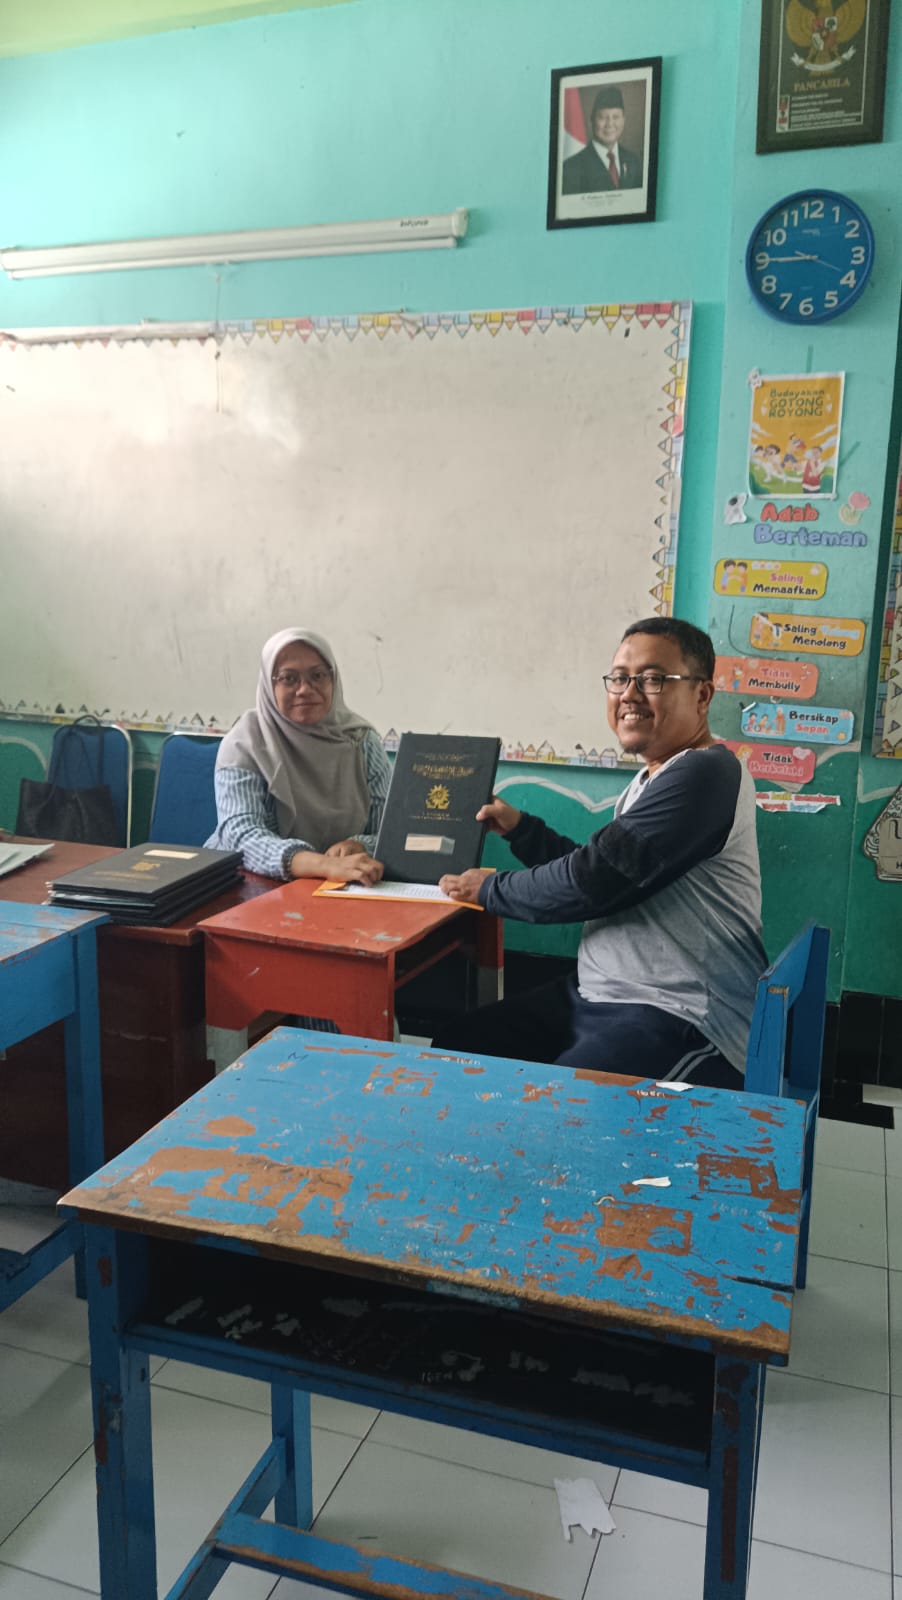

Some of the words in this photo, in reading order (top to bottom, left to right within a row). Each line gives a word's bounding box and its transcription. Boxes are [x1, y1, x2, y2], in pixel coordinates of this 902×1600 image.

[782, 210, 799, 227] 11
[801, 200, 824, 219] 12
[832, 206, 840, 223] 1
[764, 227, 787, 246] 10
[845, 220, 860, 238] 2
[755, 251, 770, 270] 9
[851, 246, 865, 265] 3
[761, 275, 776, 294] 8
[840, 270, 856, 288] 4
[779, 293, 792, 311] 7
[799, 298, 814, 316] 6
[823, 291, 839, 309] 5
[769, 396, 824, 408] GOTONG
[768, 406, 823, 418] ROYONG
[761, 503, 819, 522] Adab
[754, 524, 867, 547] Berteman
[770, 573, 804, 584] Saling
[753, 583, 818, 595] Memaafkan
[783, 623, 817, 636] Saling
[793, 636, 847, 650] Menolong
[748, 678, 801, 692] Membully
[789, 710, 839, 725] Bersikap
[762, 752, 793, 763] Tidak
